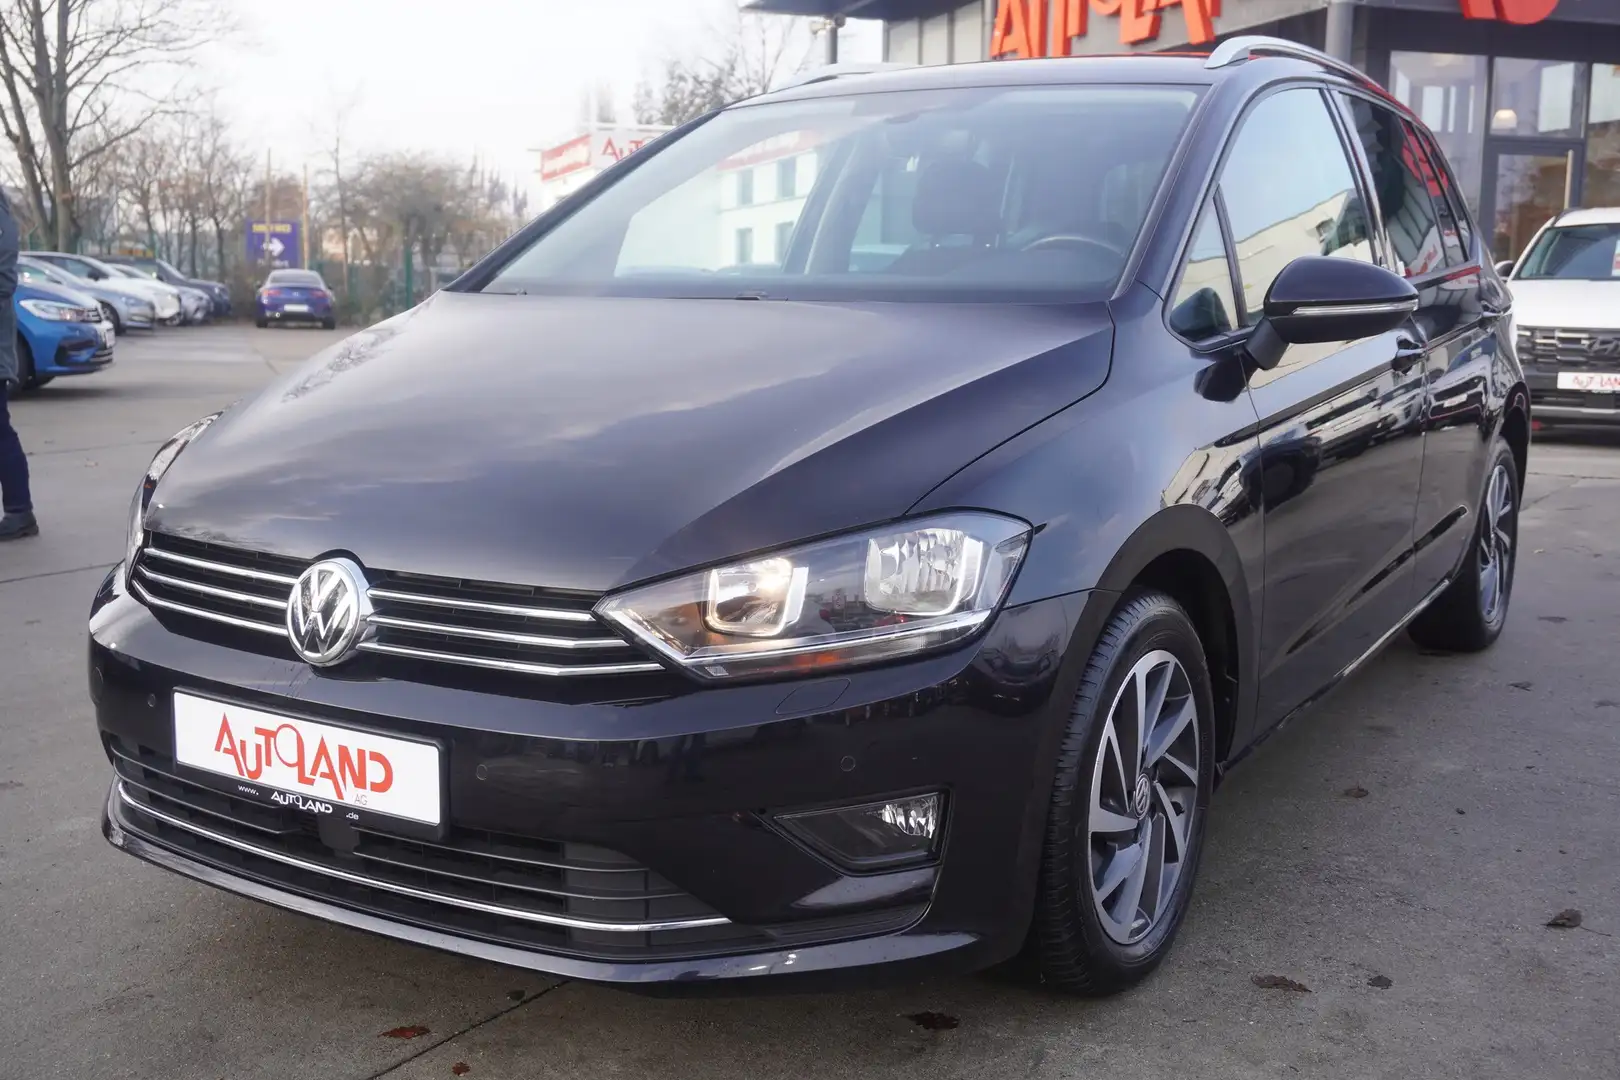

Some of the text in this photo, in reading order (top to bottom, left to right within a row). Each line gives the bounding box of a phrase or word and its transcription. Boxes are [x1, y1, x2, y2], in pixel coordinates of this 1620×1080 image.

[237, 785, 259, 796] www.
[345, 811, 359, 821] .de
[354, 794, 368, 806] AG
